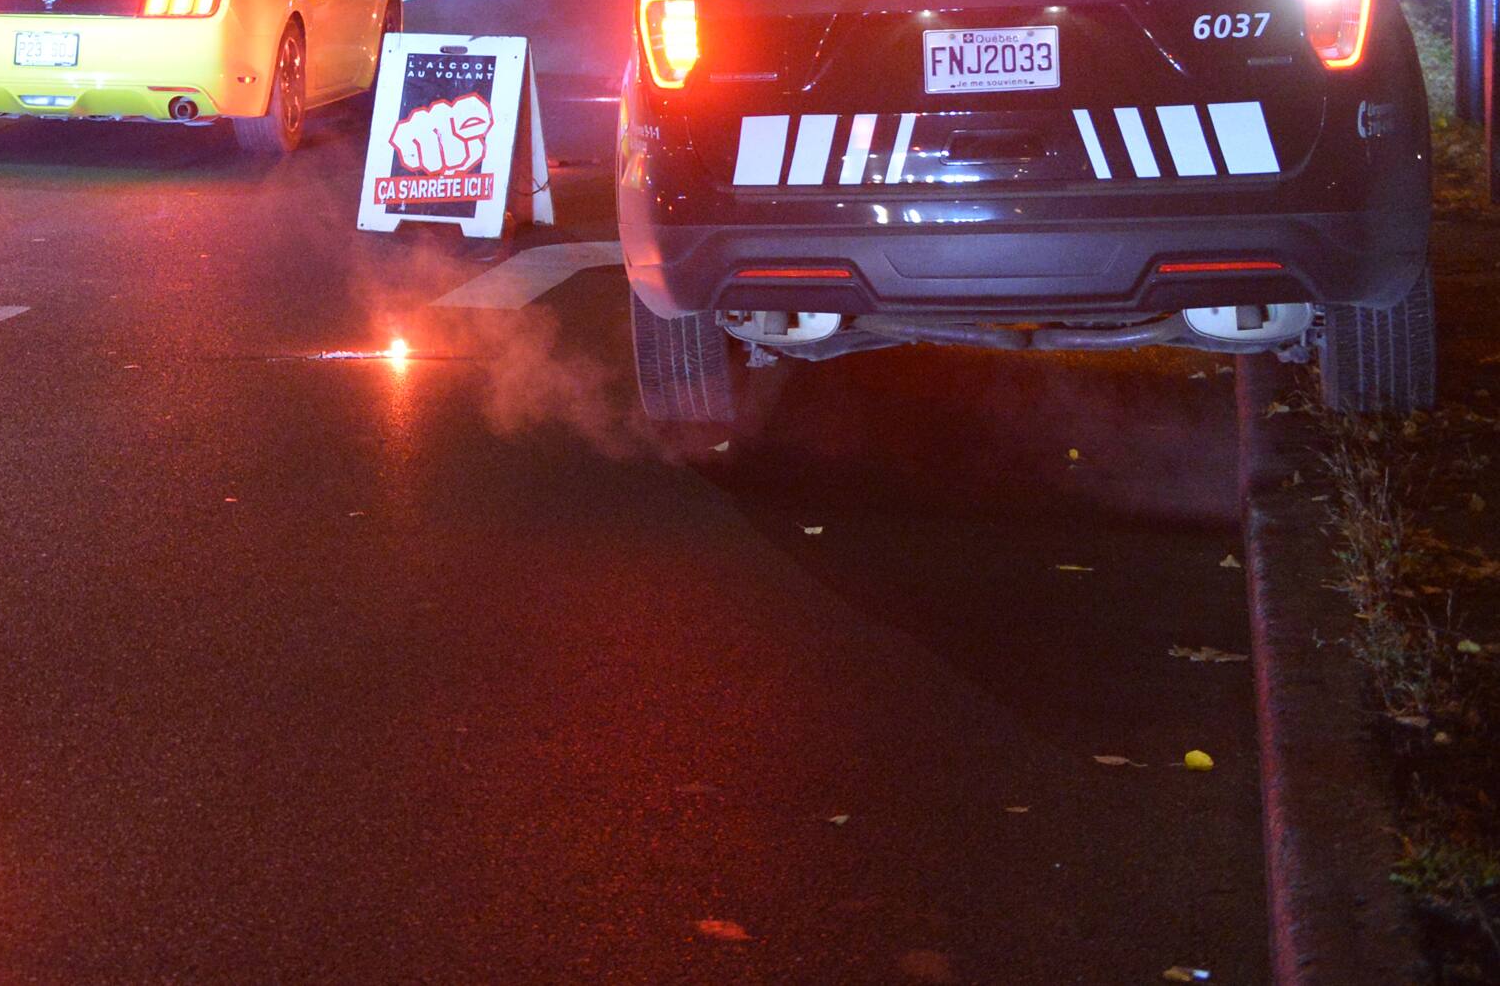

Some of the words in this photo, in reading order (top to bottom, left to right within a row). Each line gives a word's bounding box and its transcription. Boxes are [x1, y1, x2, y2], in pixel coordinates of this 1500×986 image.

[1193, 12, 1271, 40] 6037
[408, 61, 494, 71] L'ALCOOL
[931, 43, 1052, 76] FNJ2033
[407, 70, 425, 78] AU
[436, 71, 493, 80] VOLANT
[378, 180, 396, 203] ÇA
[399, 176, 461, 199] S'ARRÊTE
[464, 177, 481, 197] ICI
